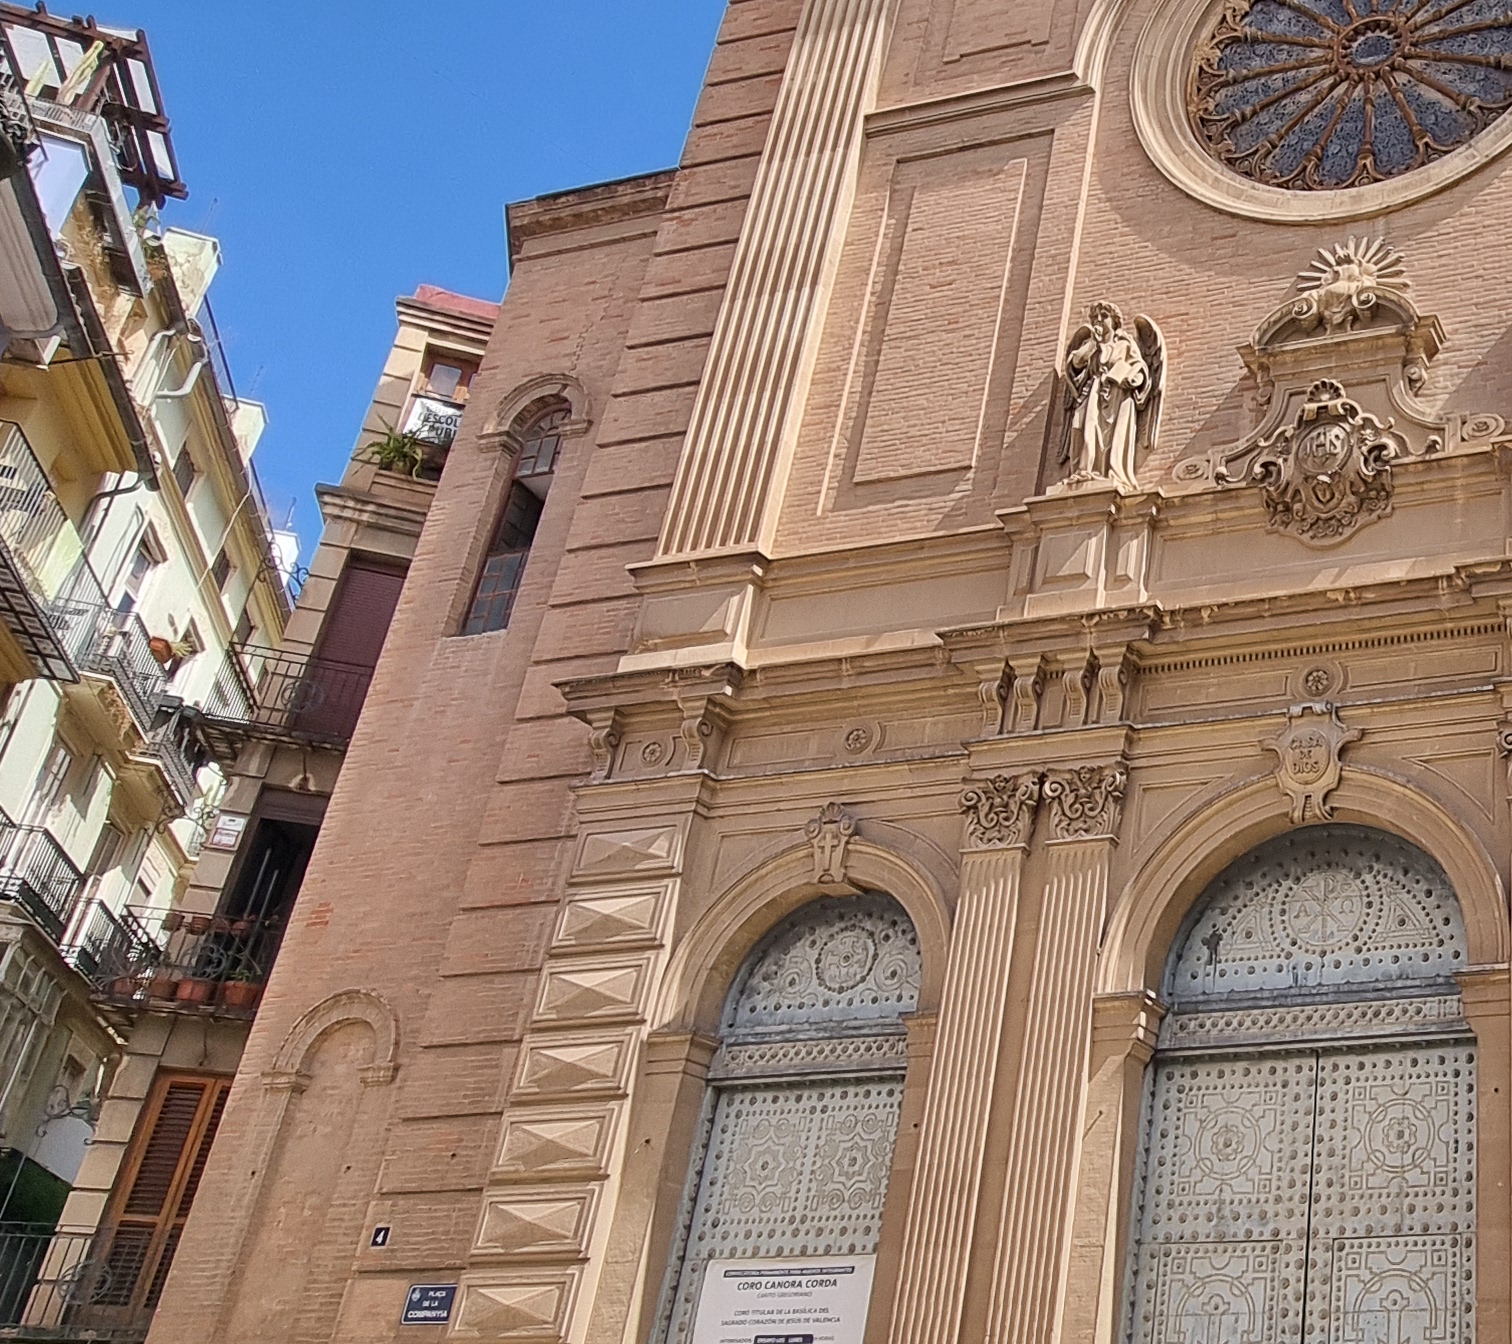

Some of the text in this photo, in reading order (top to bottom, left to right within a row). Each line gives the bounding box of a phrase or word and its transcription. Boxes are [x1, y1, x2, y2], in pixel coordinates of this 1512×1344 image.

[1292, 760, 1320, 775] DIOS
[376, 1231, 385, 1243] 4
[737, 1278, 838, 1291] CORO CANORA CORDA
